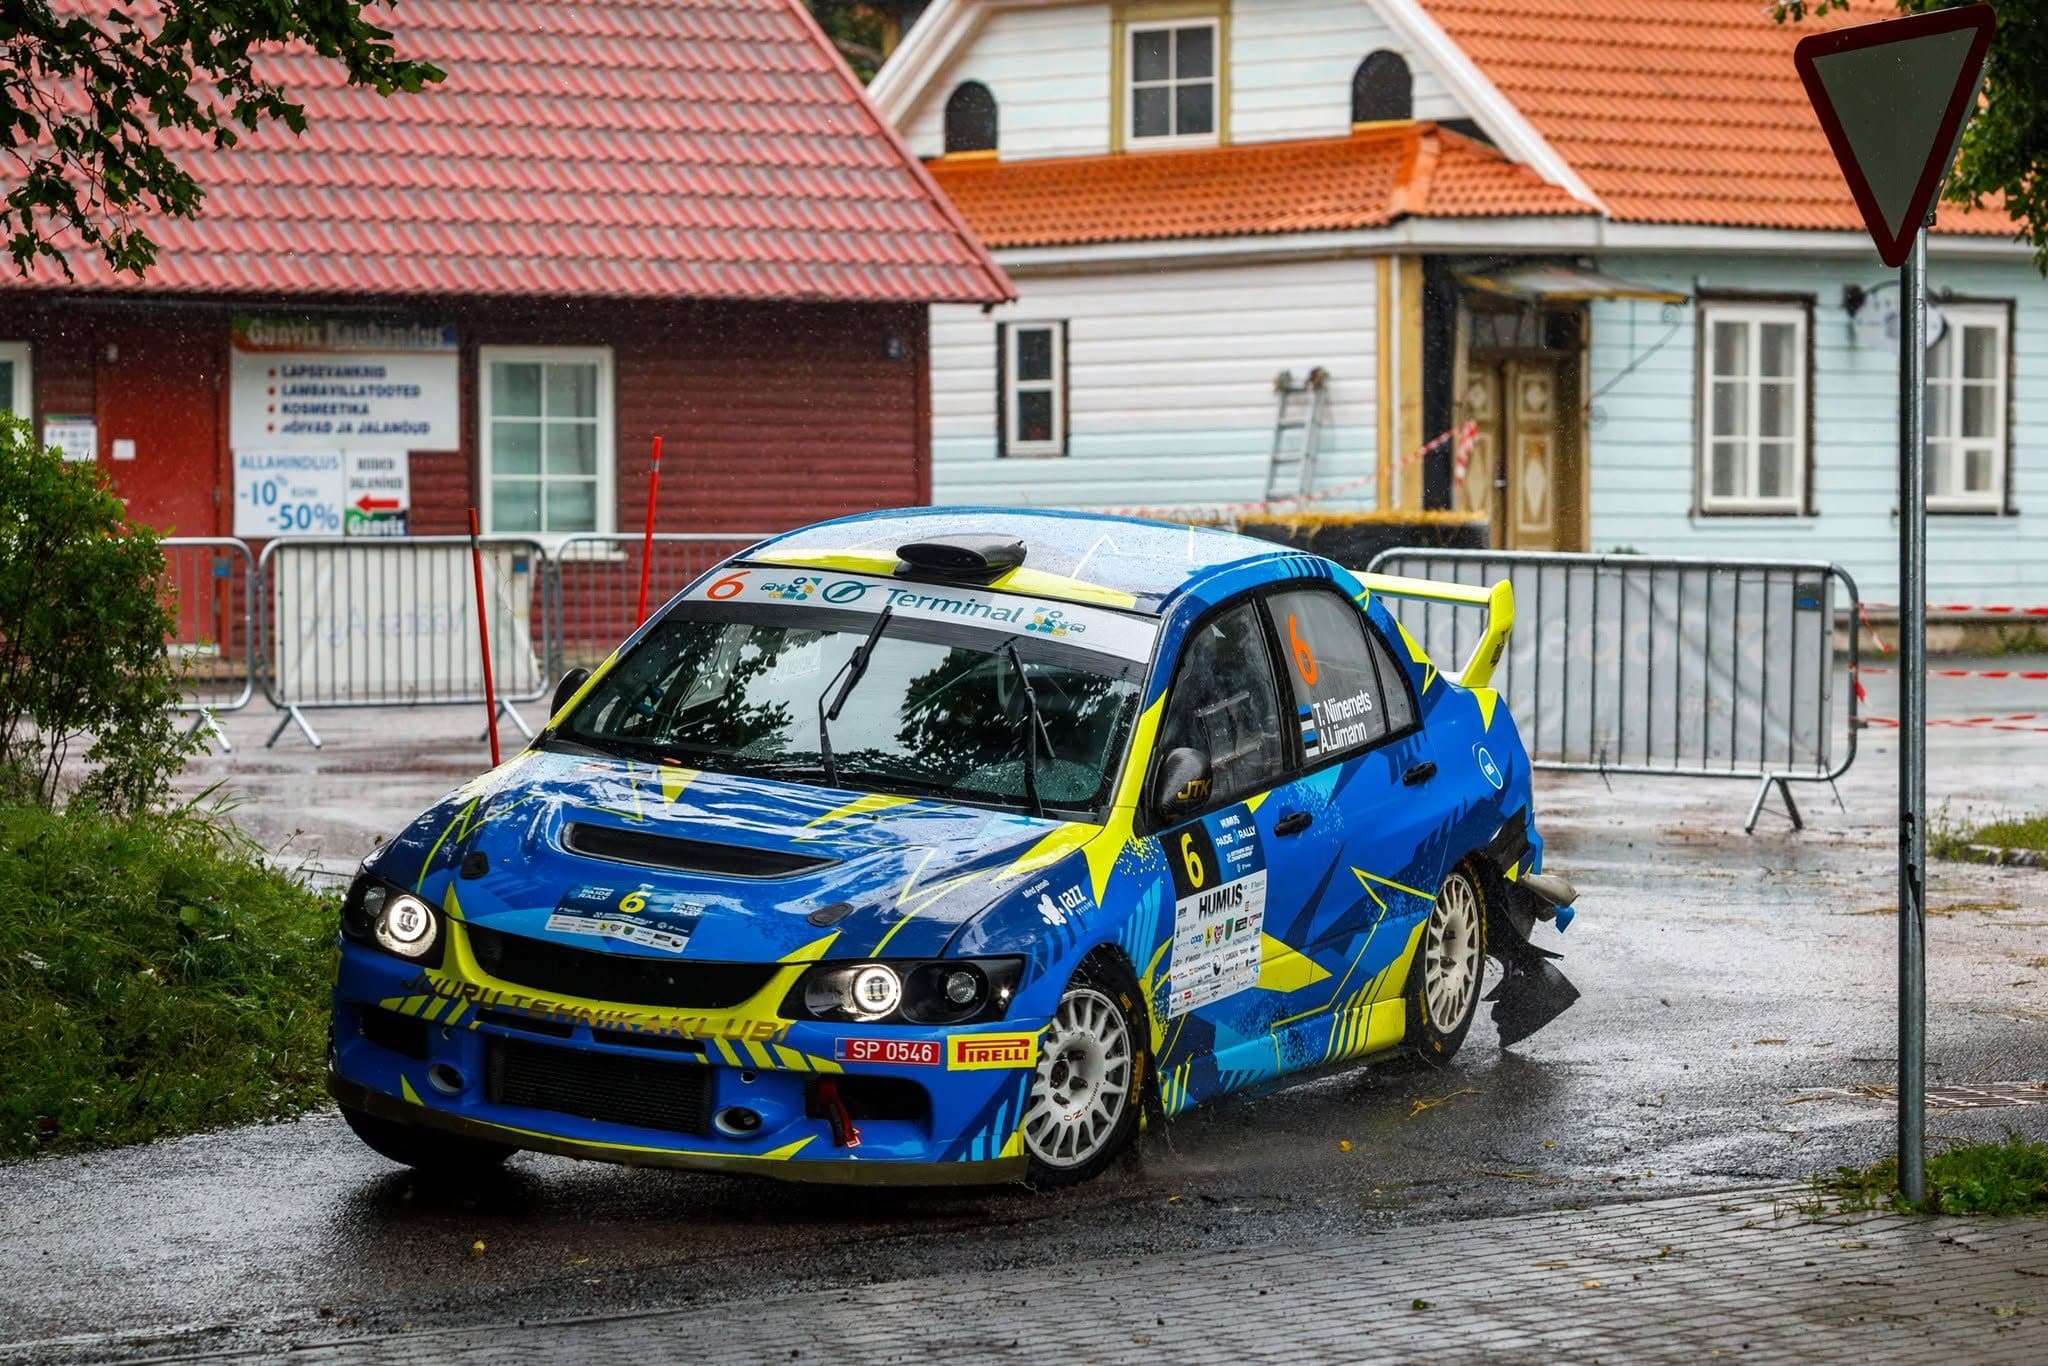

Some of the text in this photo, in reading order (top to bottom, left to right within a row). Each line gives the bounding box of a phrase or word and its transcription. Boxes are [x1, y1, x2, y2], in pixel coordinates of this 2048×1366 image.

[281, 384, 421, 398] LAMBAVILLATOOTED
[281, 403, 369, 415] KOSMEETIKA
[337, 422, 353, 434] JA
[239, 455, 339, 471] ALLAHINDLUS
[268, 503, 340, 531] -50%
[706, 569, 753, 601] 6
[886, 587, 1025, 624] Terminal
[1288, 613, 1318, 687] 6
[1324, 689, 1373, 724] Niinemets
[1176, 779, 1212, 801] JTK
[1237, 824, 1256, 840] RALLY
[1181, 832, 1205, 889] 6
[577, 893, 609, 901] RALLY
[581, 887, 613, 897] PAIDE
[619, 889, 651, 914] 6
[1199, 882, 1244, 921] HUMUS
[852, 1041, 932, 1063] SP 0546
[956, 1038, 1030, 1064] PIRELLI
